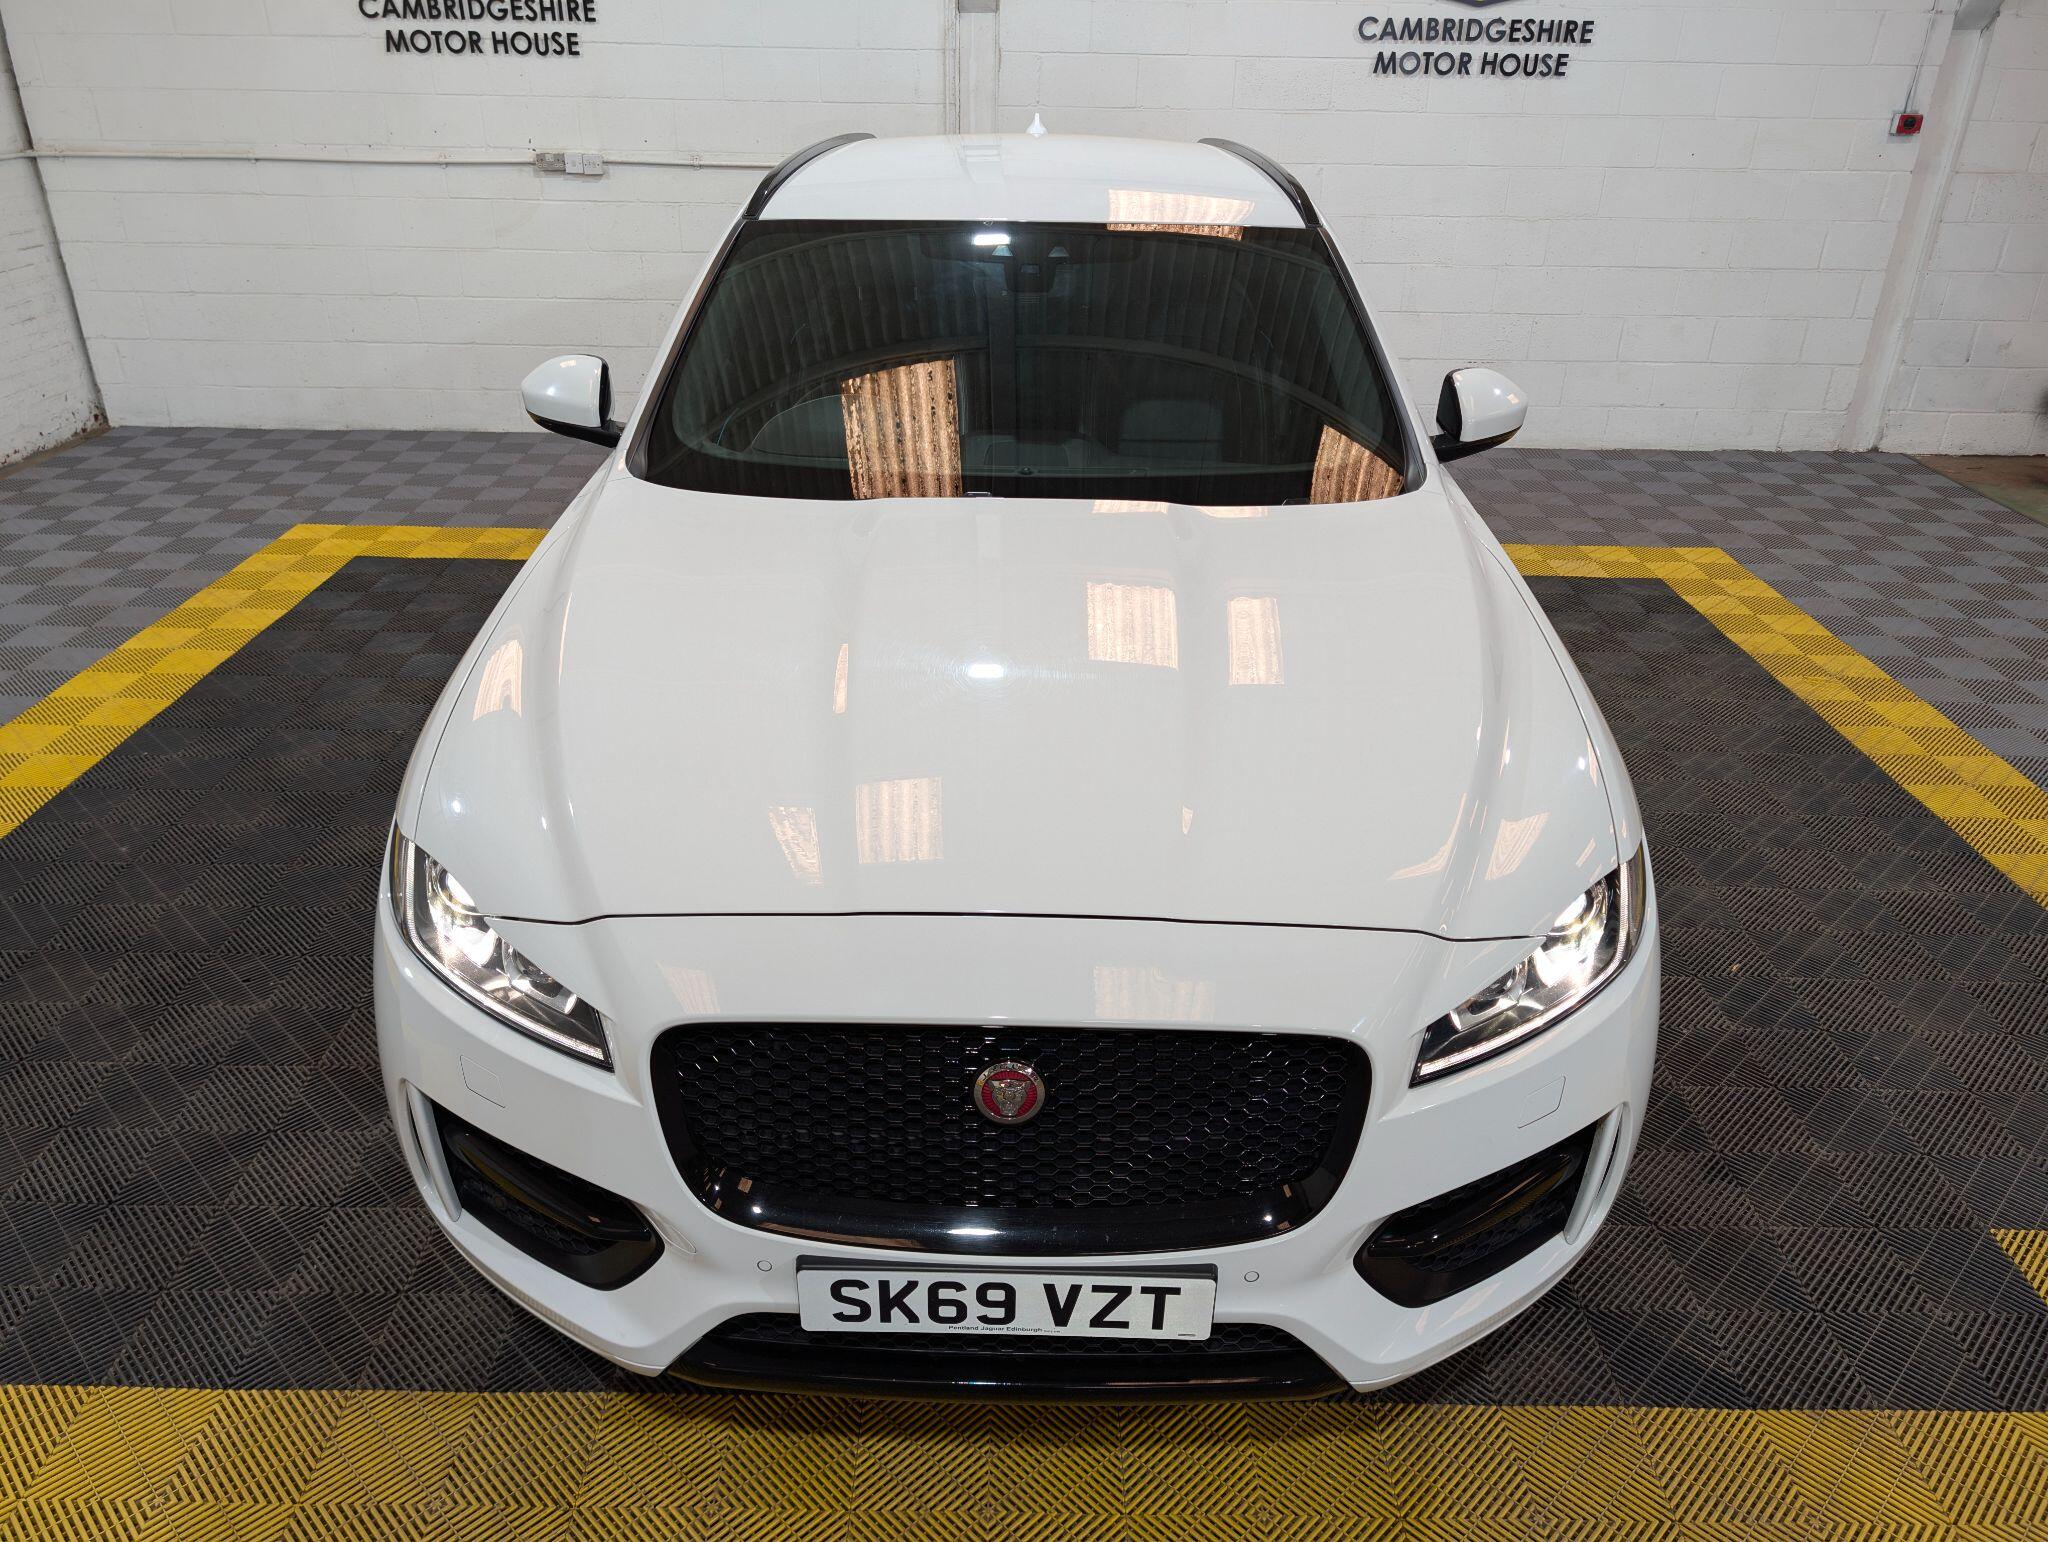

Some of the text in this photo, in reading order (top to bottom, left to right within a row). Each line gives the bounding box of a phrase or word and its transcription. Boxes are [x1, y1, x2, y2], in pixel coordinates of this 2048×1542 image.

[358, 0, 597, 23] CAMBRIDGESHIRE
[385, 29, 581, 56] MOTOR HOUSE
[1357, 16, 1595, 44] CAMBRIDGESHIRE
[1372, 51, 1570, 77] MOTOR HOUSE
[829, 1278, 1182, 1331] SK69 VZT
